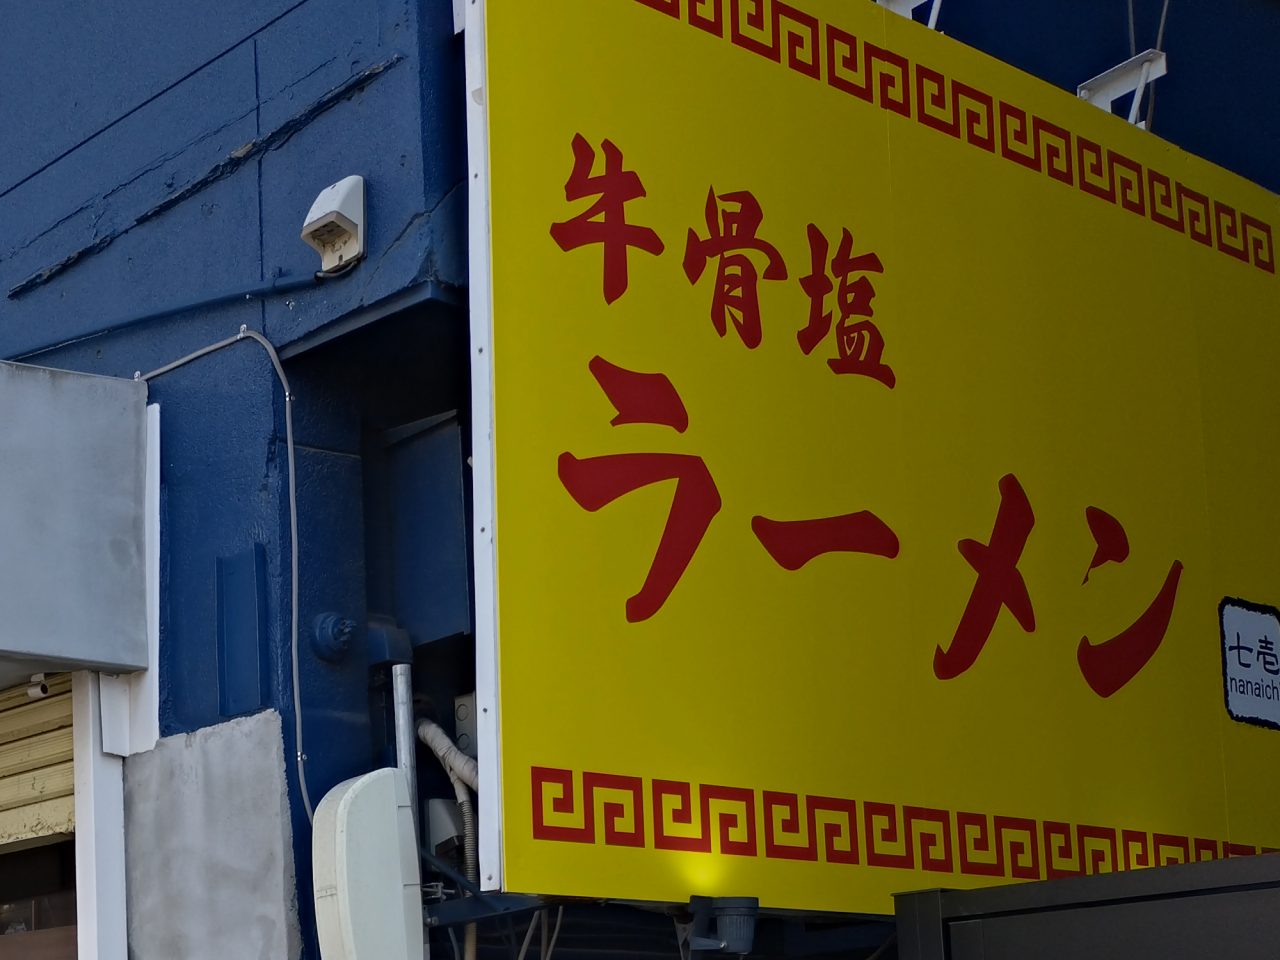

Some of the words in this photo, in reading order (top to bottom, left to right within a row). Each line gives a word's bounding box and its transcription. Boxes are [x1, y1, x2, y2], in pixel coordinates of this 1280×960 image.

[550, 133, 897, 389] 牛骨塩
[557, 355, 1184, 699] ラーメン
[1228, 632, 1280, 676] 七壱
[1229, 676, 1280, 701] nanaich
